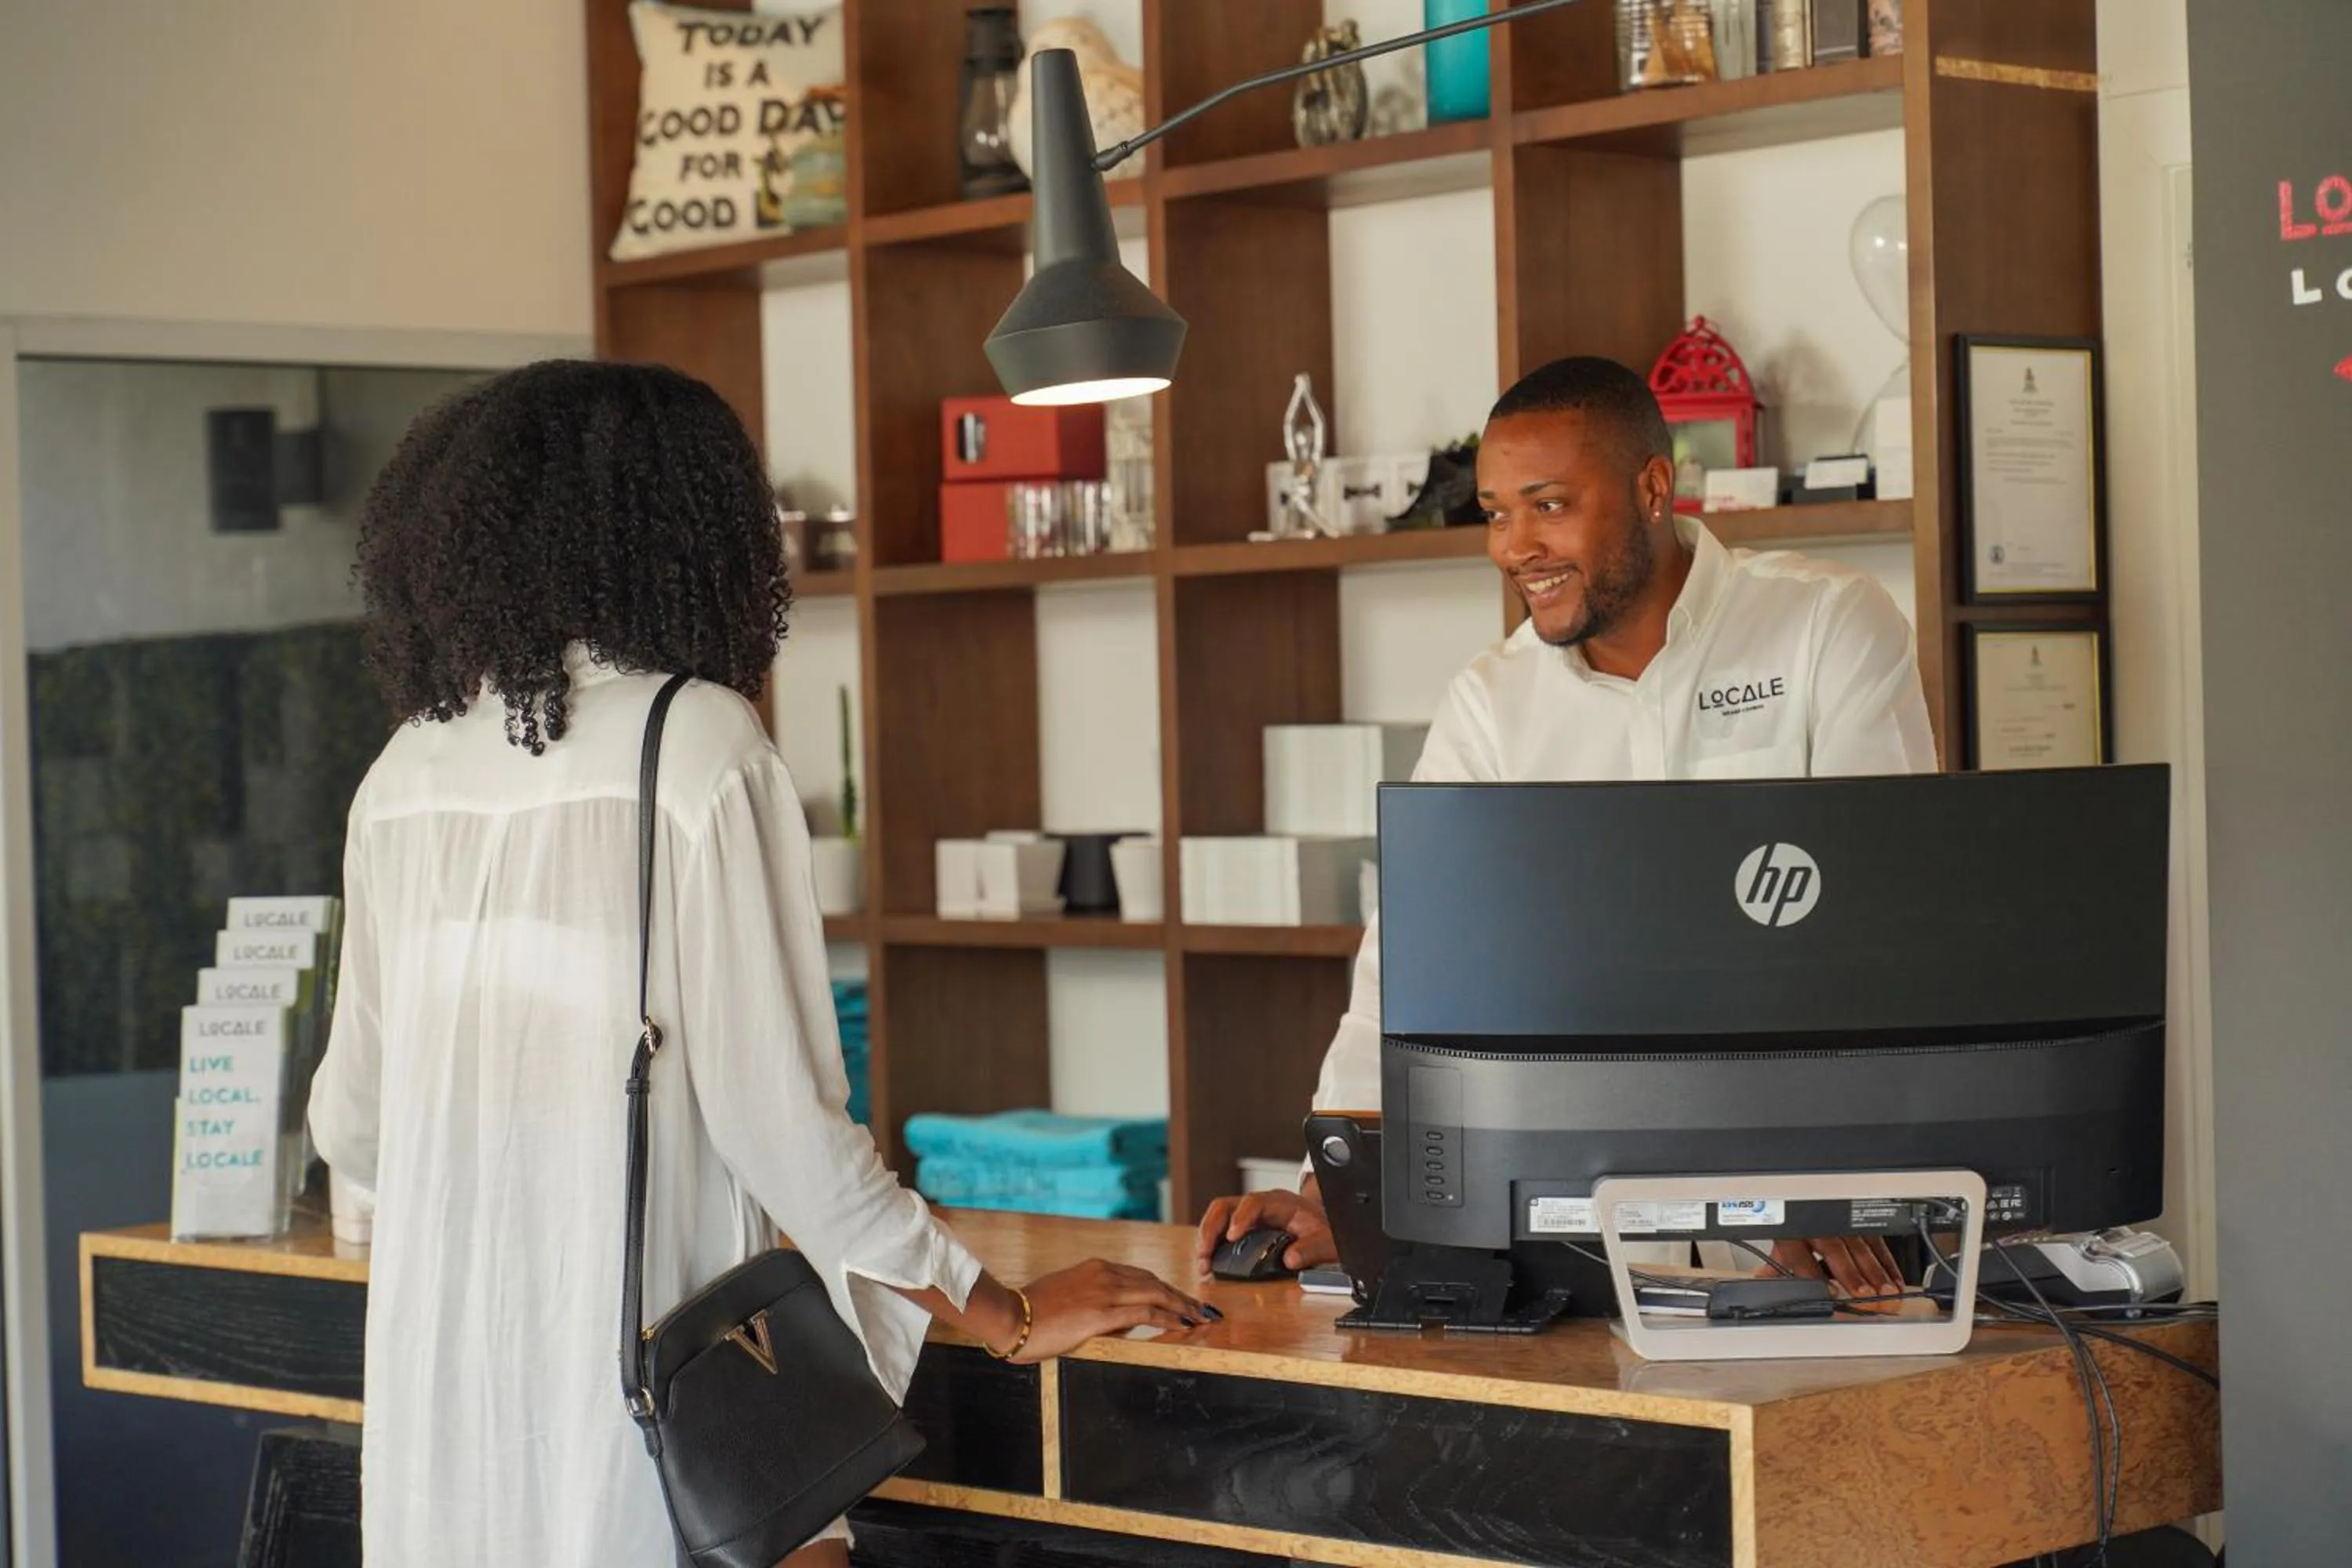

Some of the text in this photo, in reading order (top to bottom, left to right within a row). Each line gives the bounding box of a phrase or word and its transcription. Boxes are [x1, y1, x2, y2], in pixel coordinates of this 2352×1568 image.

[677, 16, 823, 53] TODAY
[706, 60, 770, 88] IS A
[679, 153, 742, 182] FOR
[1699, 677, 1784, 710] LOCALE
[1745, 843, 1813, 926] hp
[245, 911, 310, 927] LOCALE
[234, 945, 299, 960] LOCALE
[216, 984, 281, 1000] LOCALE
[199, 1021, 266, 1036] LOCALE
[190, 1056, 235, 1073] LIVE
[187, 1120, 234, 1136] STAY
[187, 1150, 263, 1168] LOCALE
